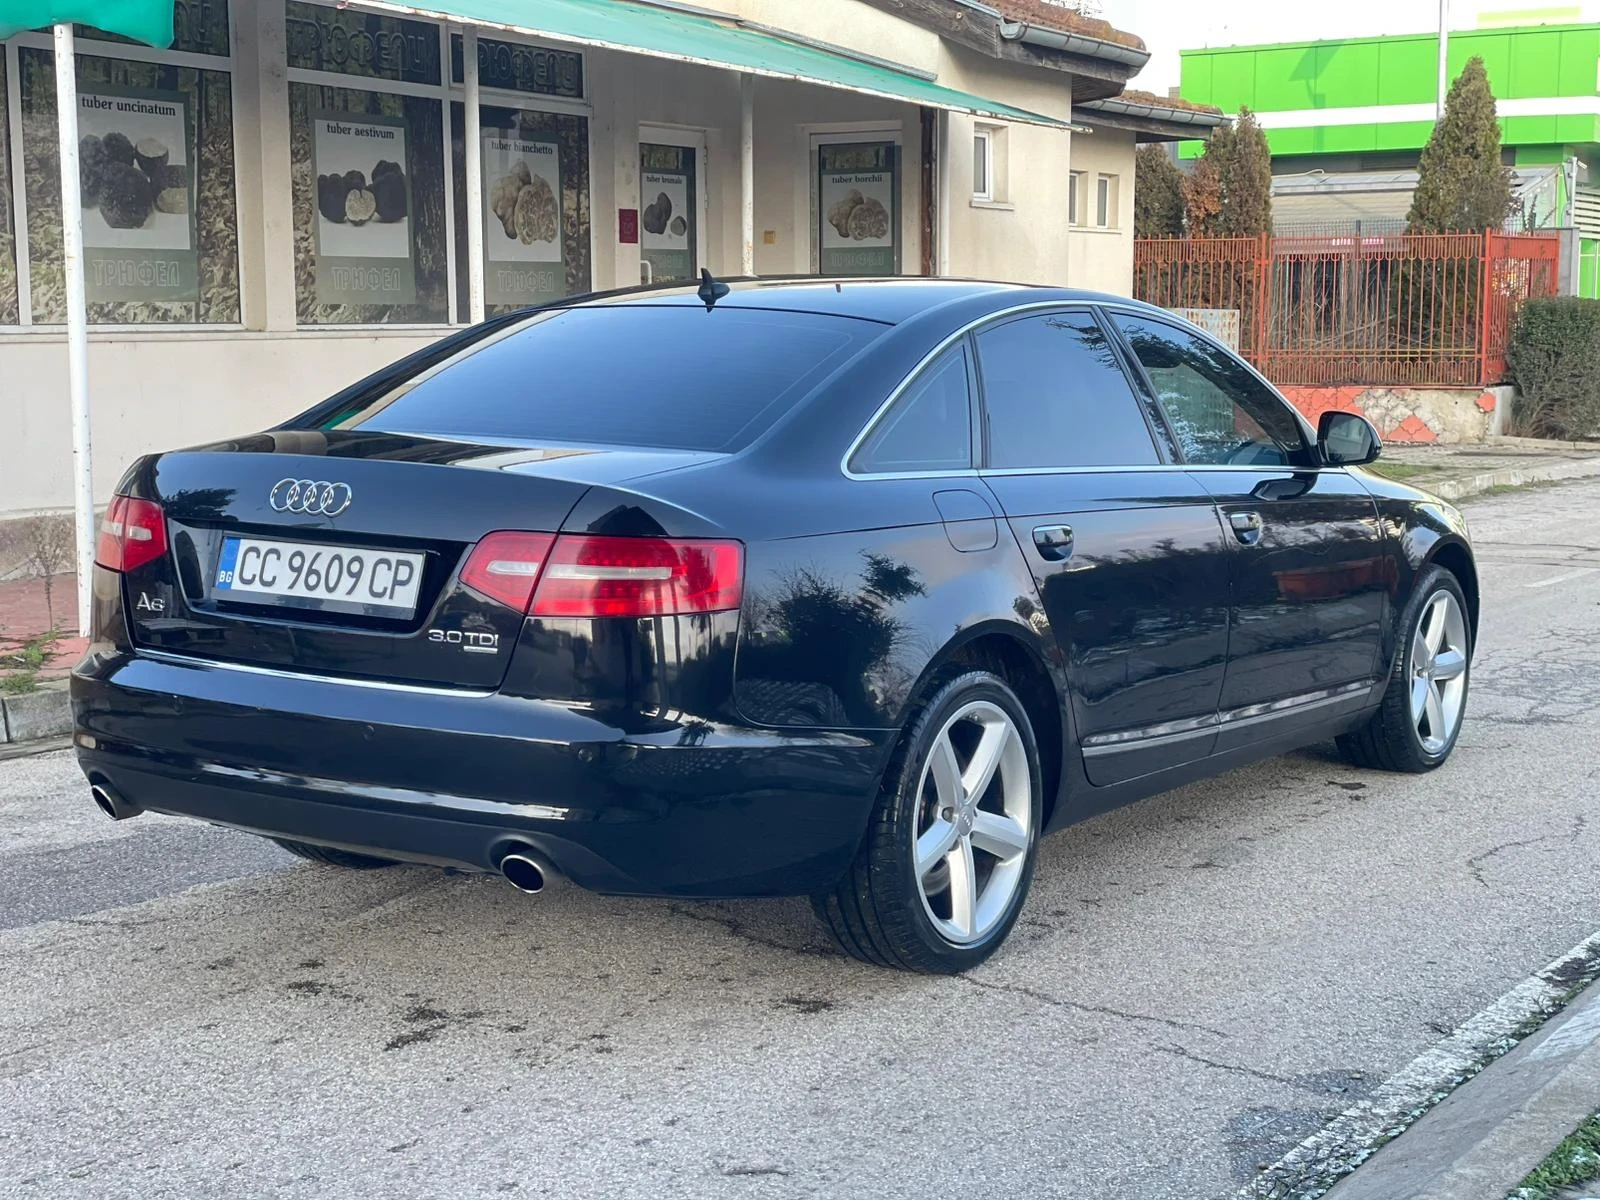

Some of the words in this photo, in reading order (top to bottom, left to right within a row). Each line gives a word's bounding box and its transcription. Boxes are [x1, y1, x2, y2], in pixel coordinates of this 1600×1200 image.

[81, 96, 113, 110] tuber
[116, 101, 176, 117] uncinatum
[327, 122, 352, 135] tuber
[354, 127, 395, 139] aestivum
[491, 139, 512, 151] tuber
[832, 176, 852, 184] tuber
[219, 570, 233, 583] BG
[287, 550, 364, 596] 9609
[136, 591, 165, 611] A6
[463, 632, 499, 647] TDI
